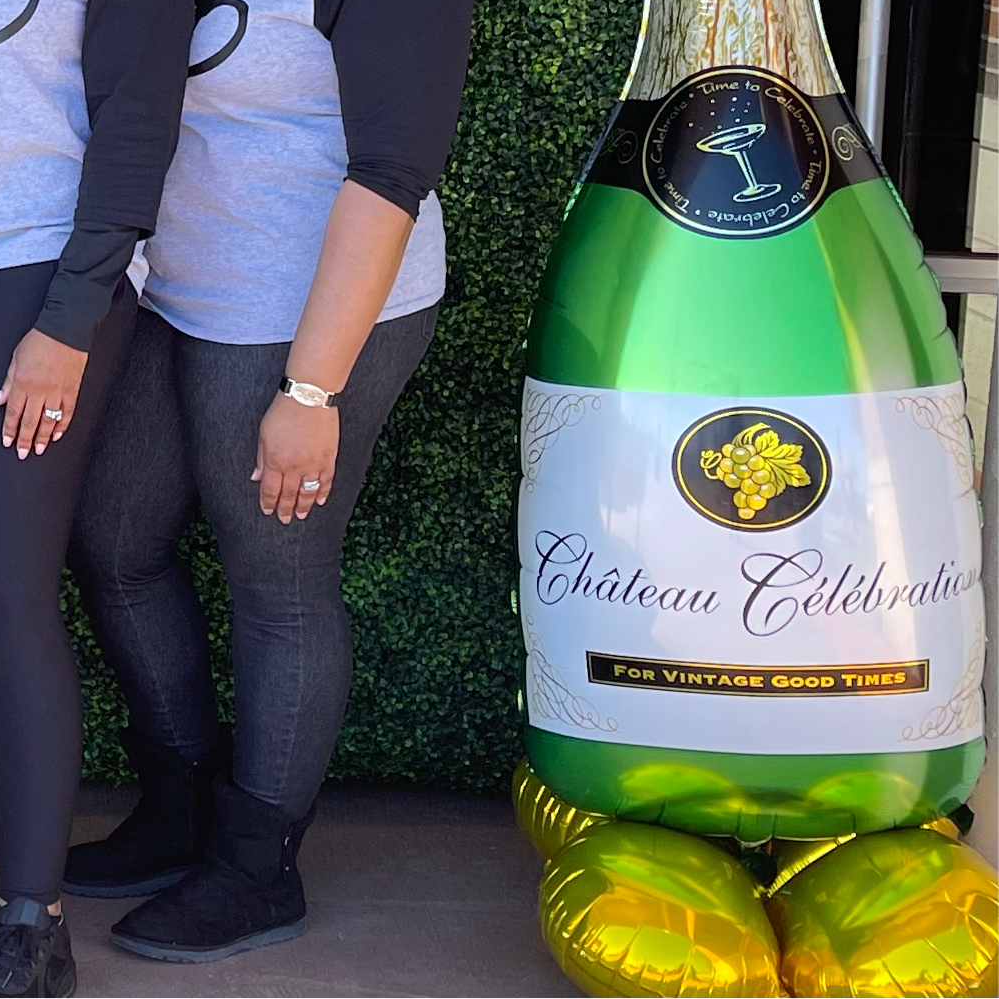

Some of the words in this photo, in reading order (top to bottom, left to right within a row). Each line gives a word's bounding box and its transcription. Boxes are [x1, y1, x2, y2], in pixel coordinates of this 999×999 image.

[696, 81, 739, 95] Time
[745, 80, 761, 92] to
[764, 86, 815, 145] Celebrate
[650, 101, 688, 163] Celebrate
[800, 160, 822, 191] Time
[663, 181, 690, 214] Time
[790, 191, 806, 204] to
[707, 203, 790, 227] Celebrate
[535, 530, 721, 614] Château
